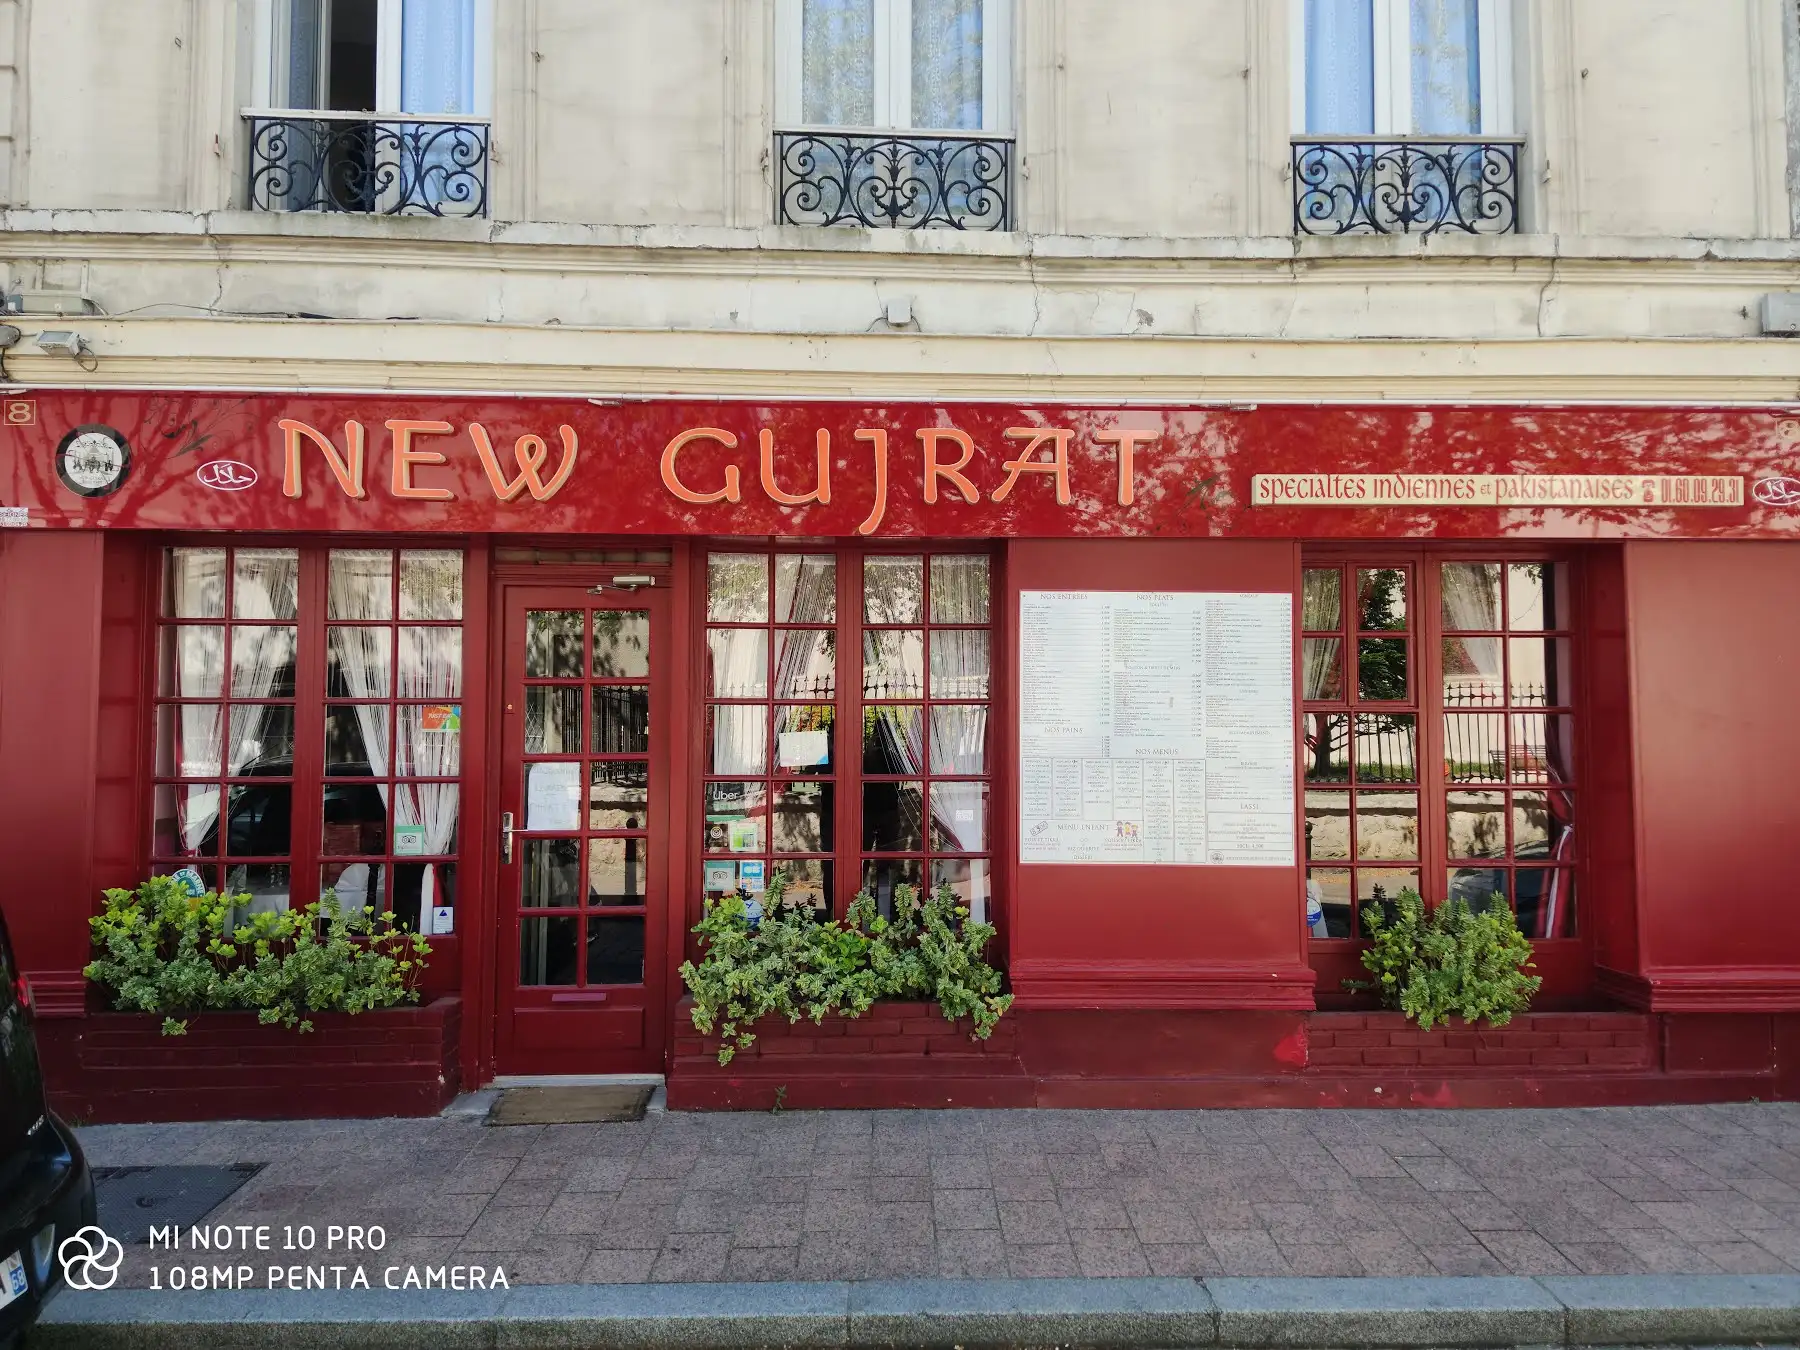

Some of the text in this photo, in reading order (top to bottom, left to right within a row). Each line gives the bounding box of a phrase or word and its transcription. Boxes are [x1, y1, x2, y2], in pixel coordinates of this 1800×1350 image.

[9, 403, 31, 423] 8
[278, 418, 1160, 536] NEW GUJRAT
[1661, 478, 1739, 503] 01.60.09.29.31
[713, 790, 739, 800] Uber
[11, 1270, 25, 1290] 68
